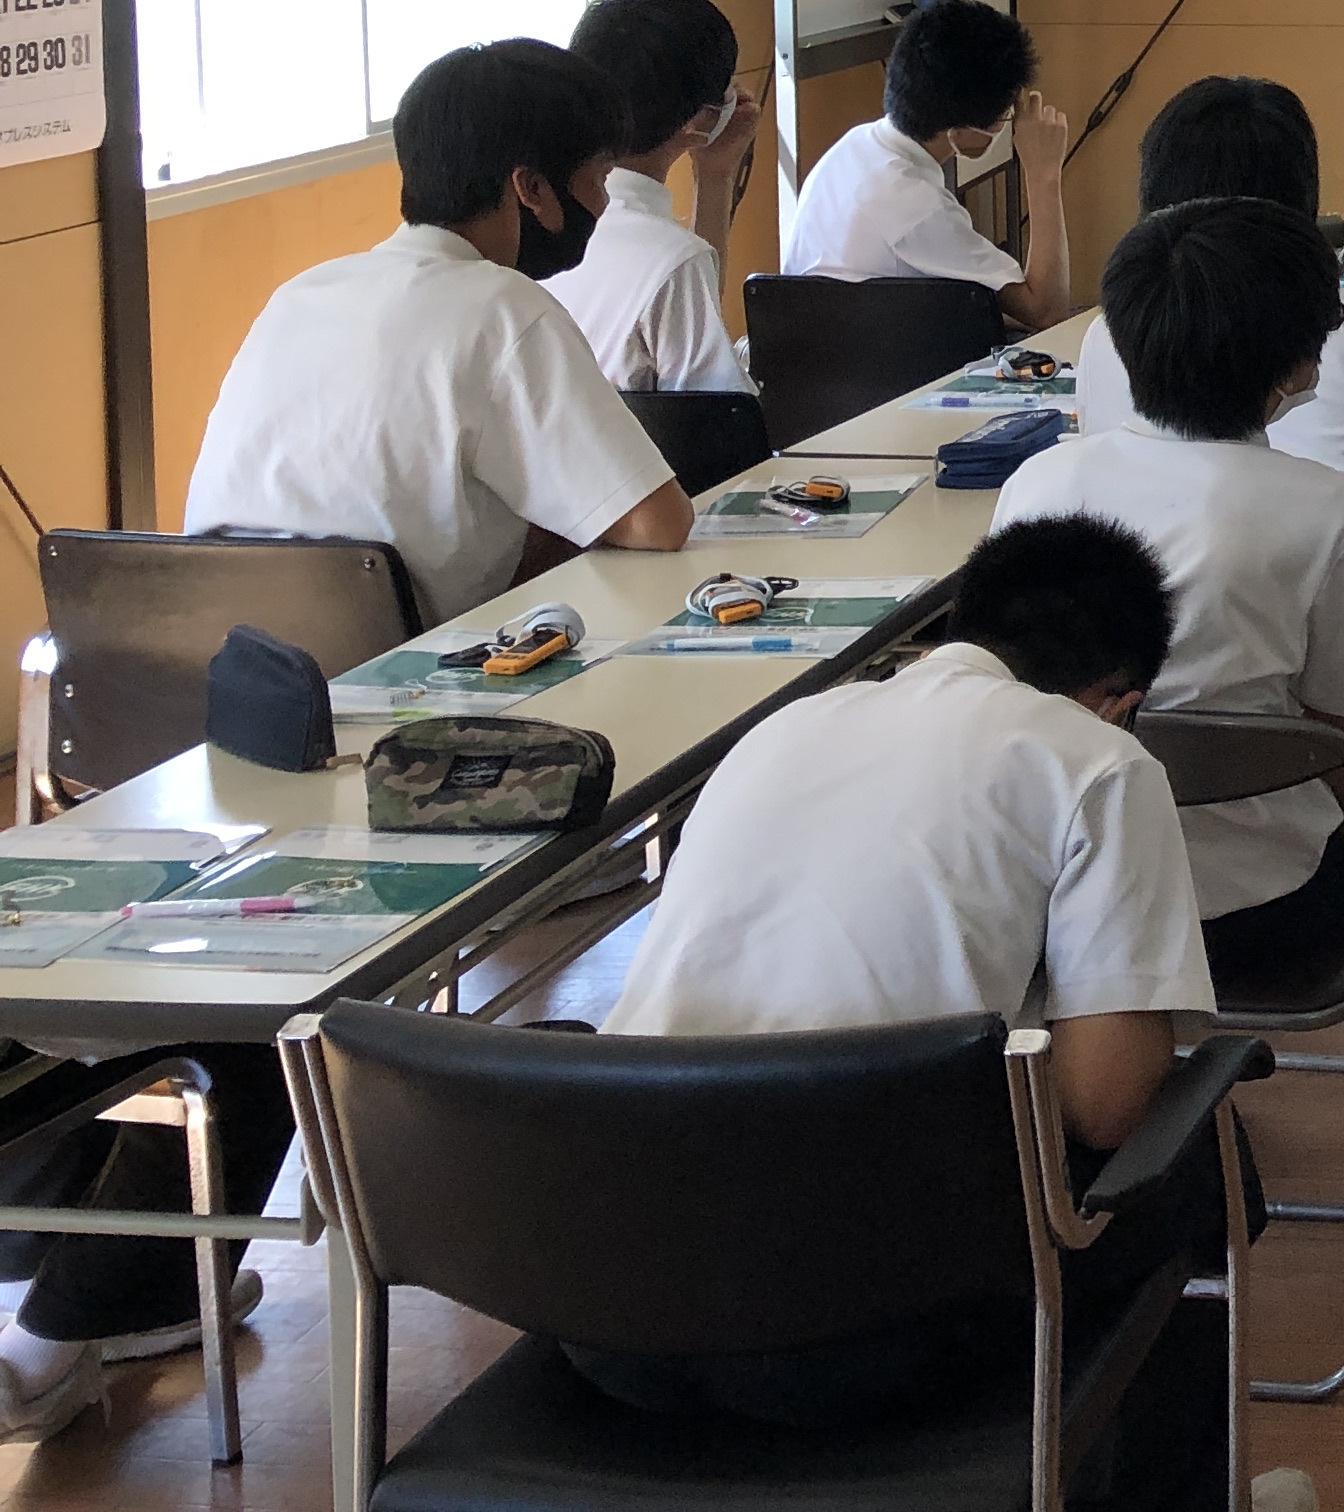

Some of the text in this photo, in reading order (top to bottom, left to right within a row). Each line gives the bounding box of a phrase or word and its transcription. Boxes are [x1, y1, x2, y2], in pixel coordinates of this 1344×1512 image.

[16, 41, 39, 75] 29
[43, 37, 66, 70] 30
[71, 33, 91, 66] 31
